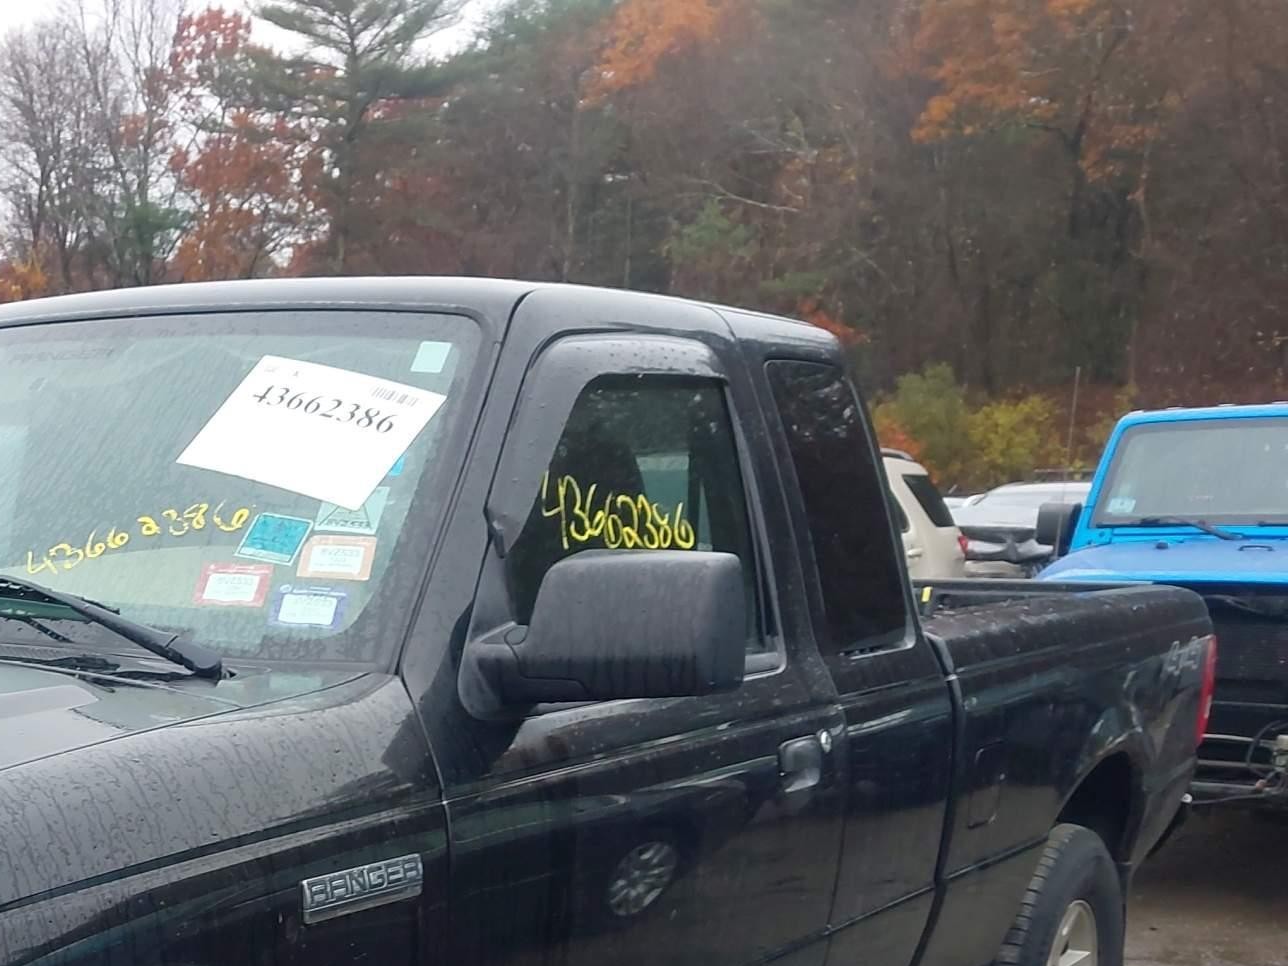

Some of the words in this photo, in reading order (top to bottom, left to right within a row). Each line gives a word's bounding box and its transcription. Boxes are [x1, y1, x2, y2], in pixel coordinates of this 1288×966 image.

[252, 384, 399, 434] 43662386
[541, 470, 695, 549] 43662386
[309, 858, 423, 908] RANGER
